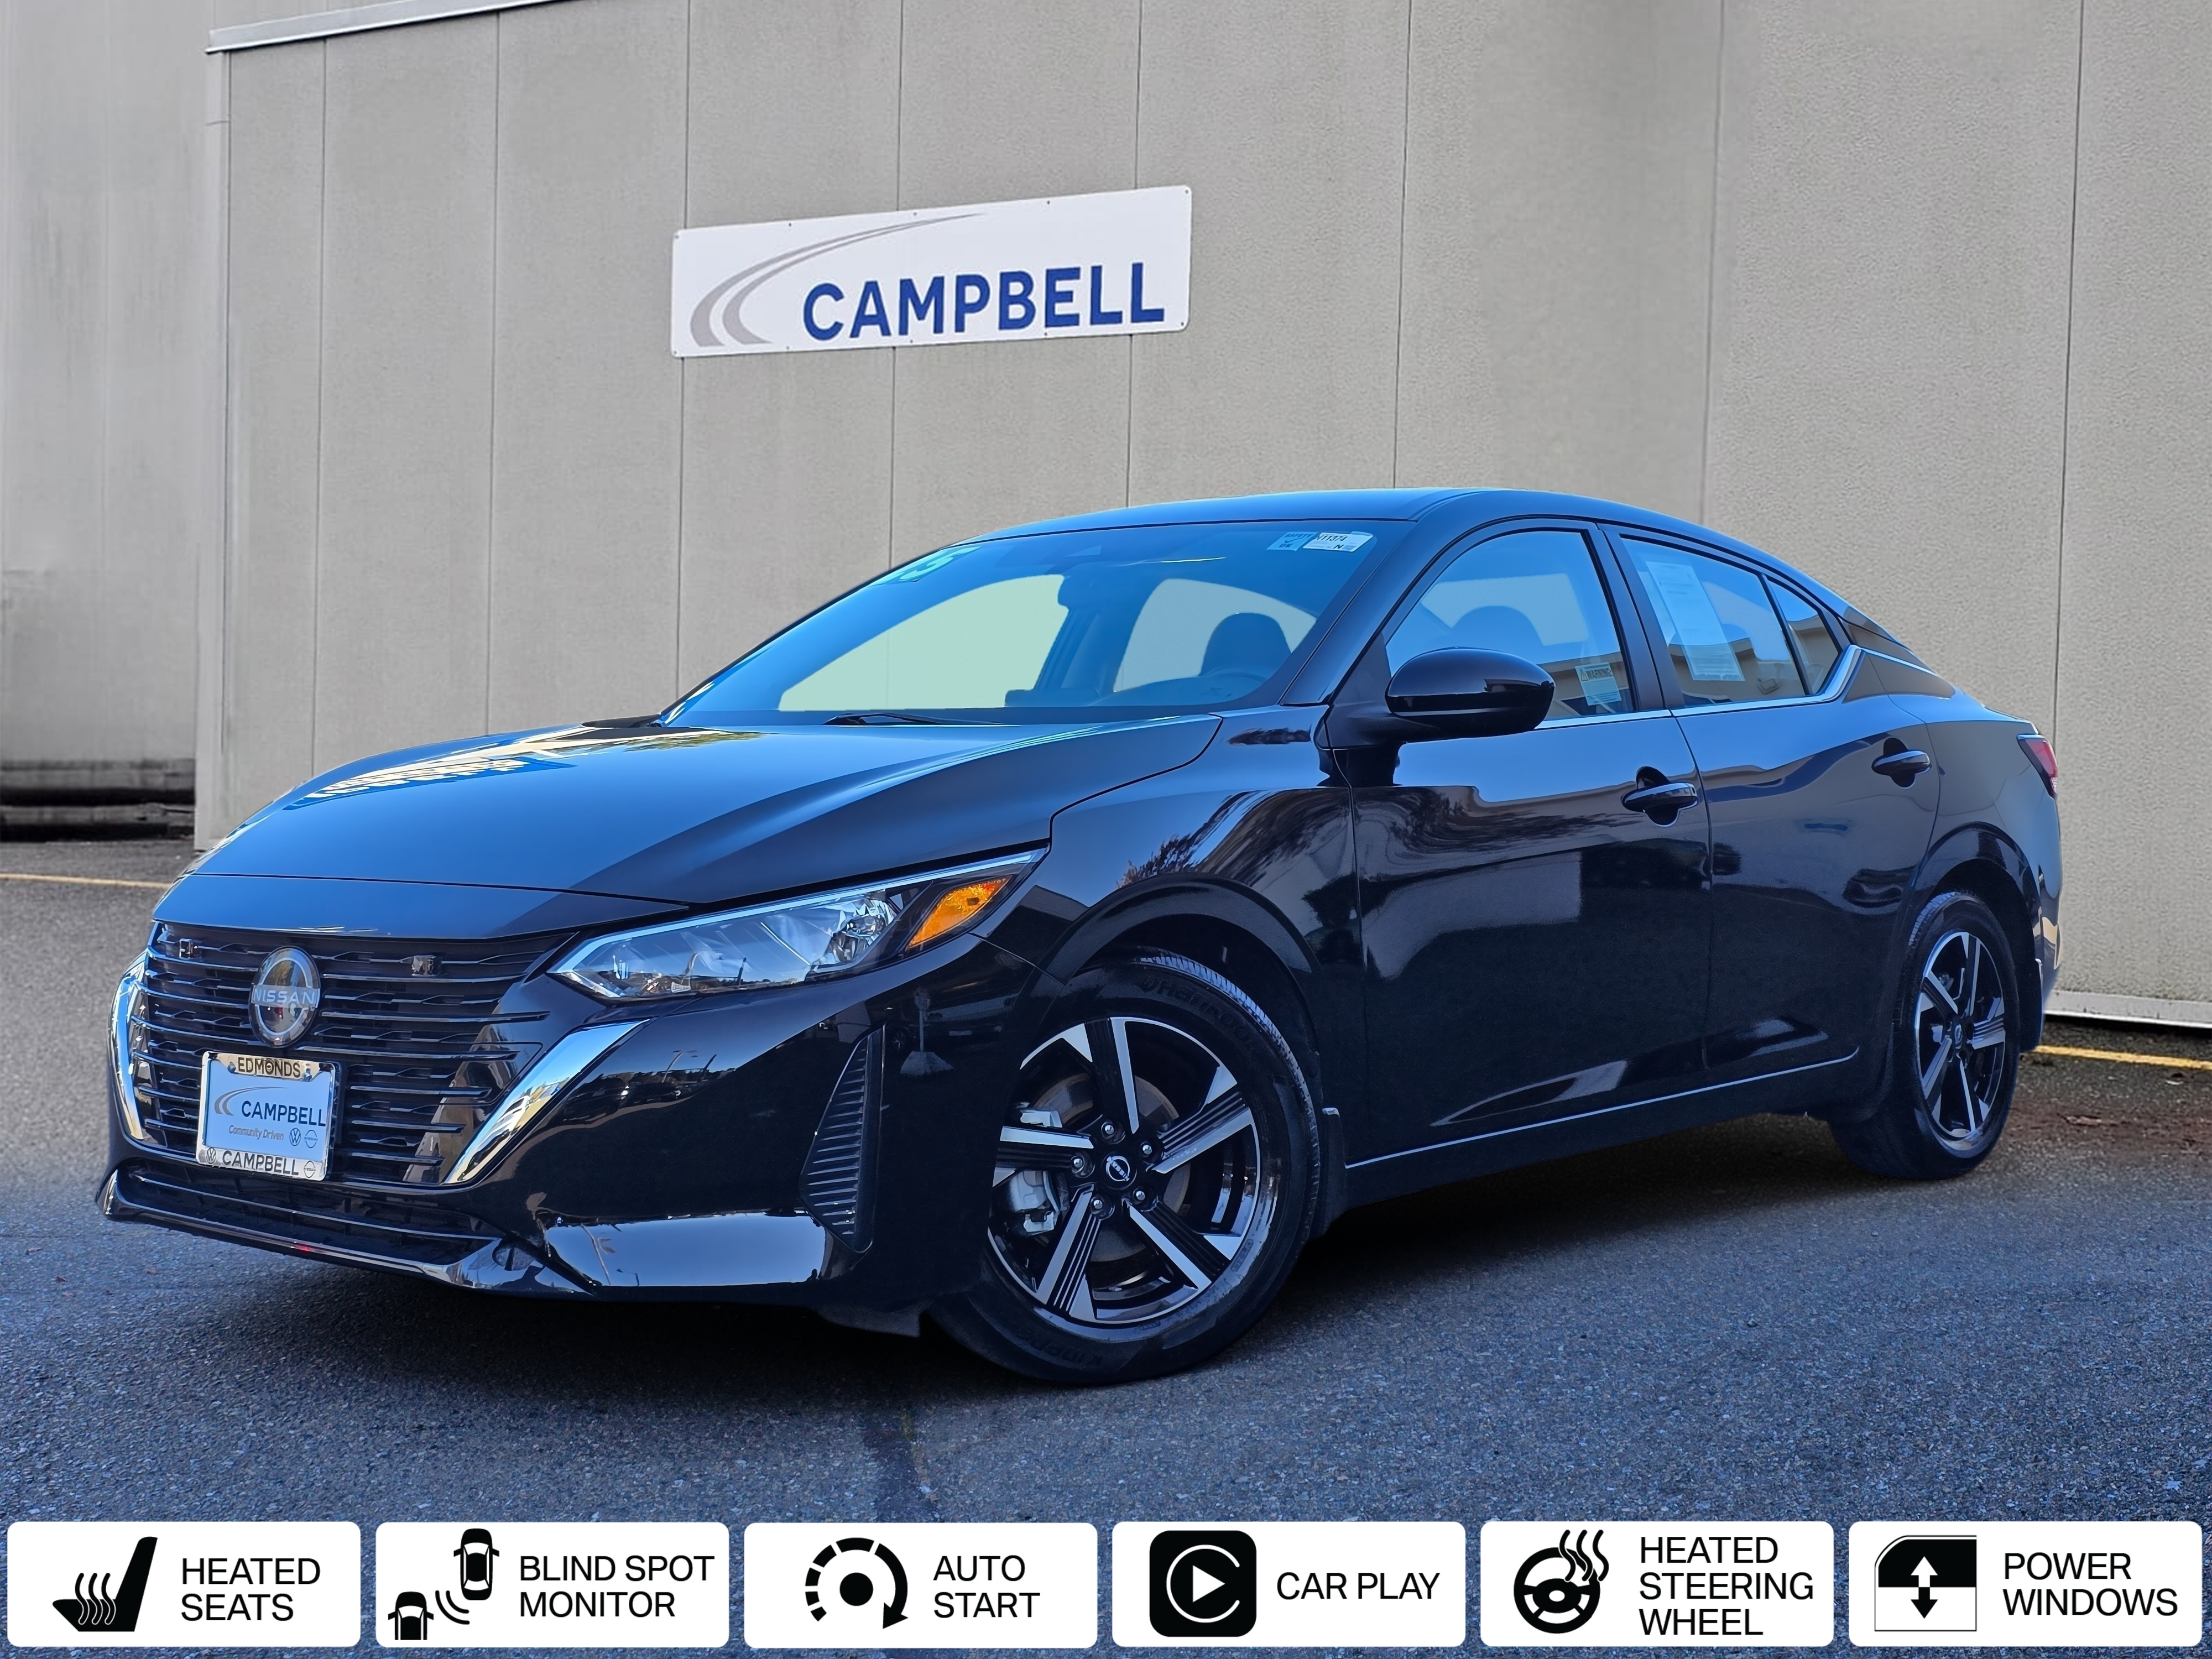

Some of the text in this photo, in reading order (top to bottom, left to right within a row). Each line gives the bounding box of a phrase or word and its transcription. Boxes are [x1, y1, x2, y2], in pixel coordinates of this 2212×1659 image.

[804, 262, 1165, 341] CAMPBELL
[254, 988, 315, 1004] NISSAN
[238, 1057, 301, 1078] EDMONDS
[241, 1100, 326, 1127] CAMPBELL
[229, 1125, 284, 1141] Community Driven
[222, 1150, 299, 1176] CAMPBELL
